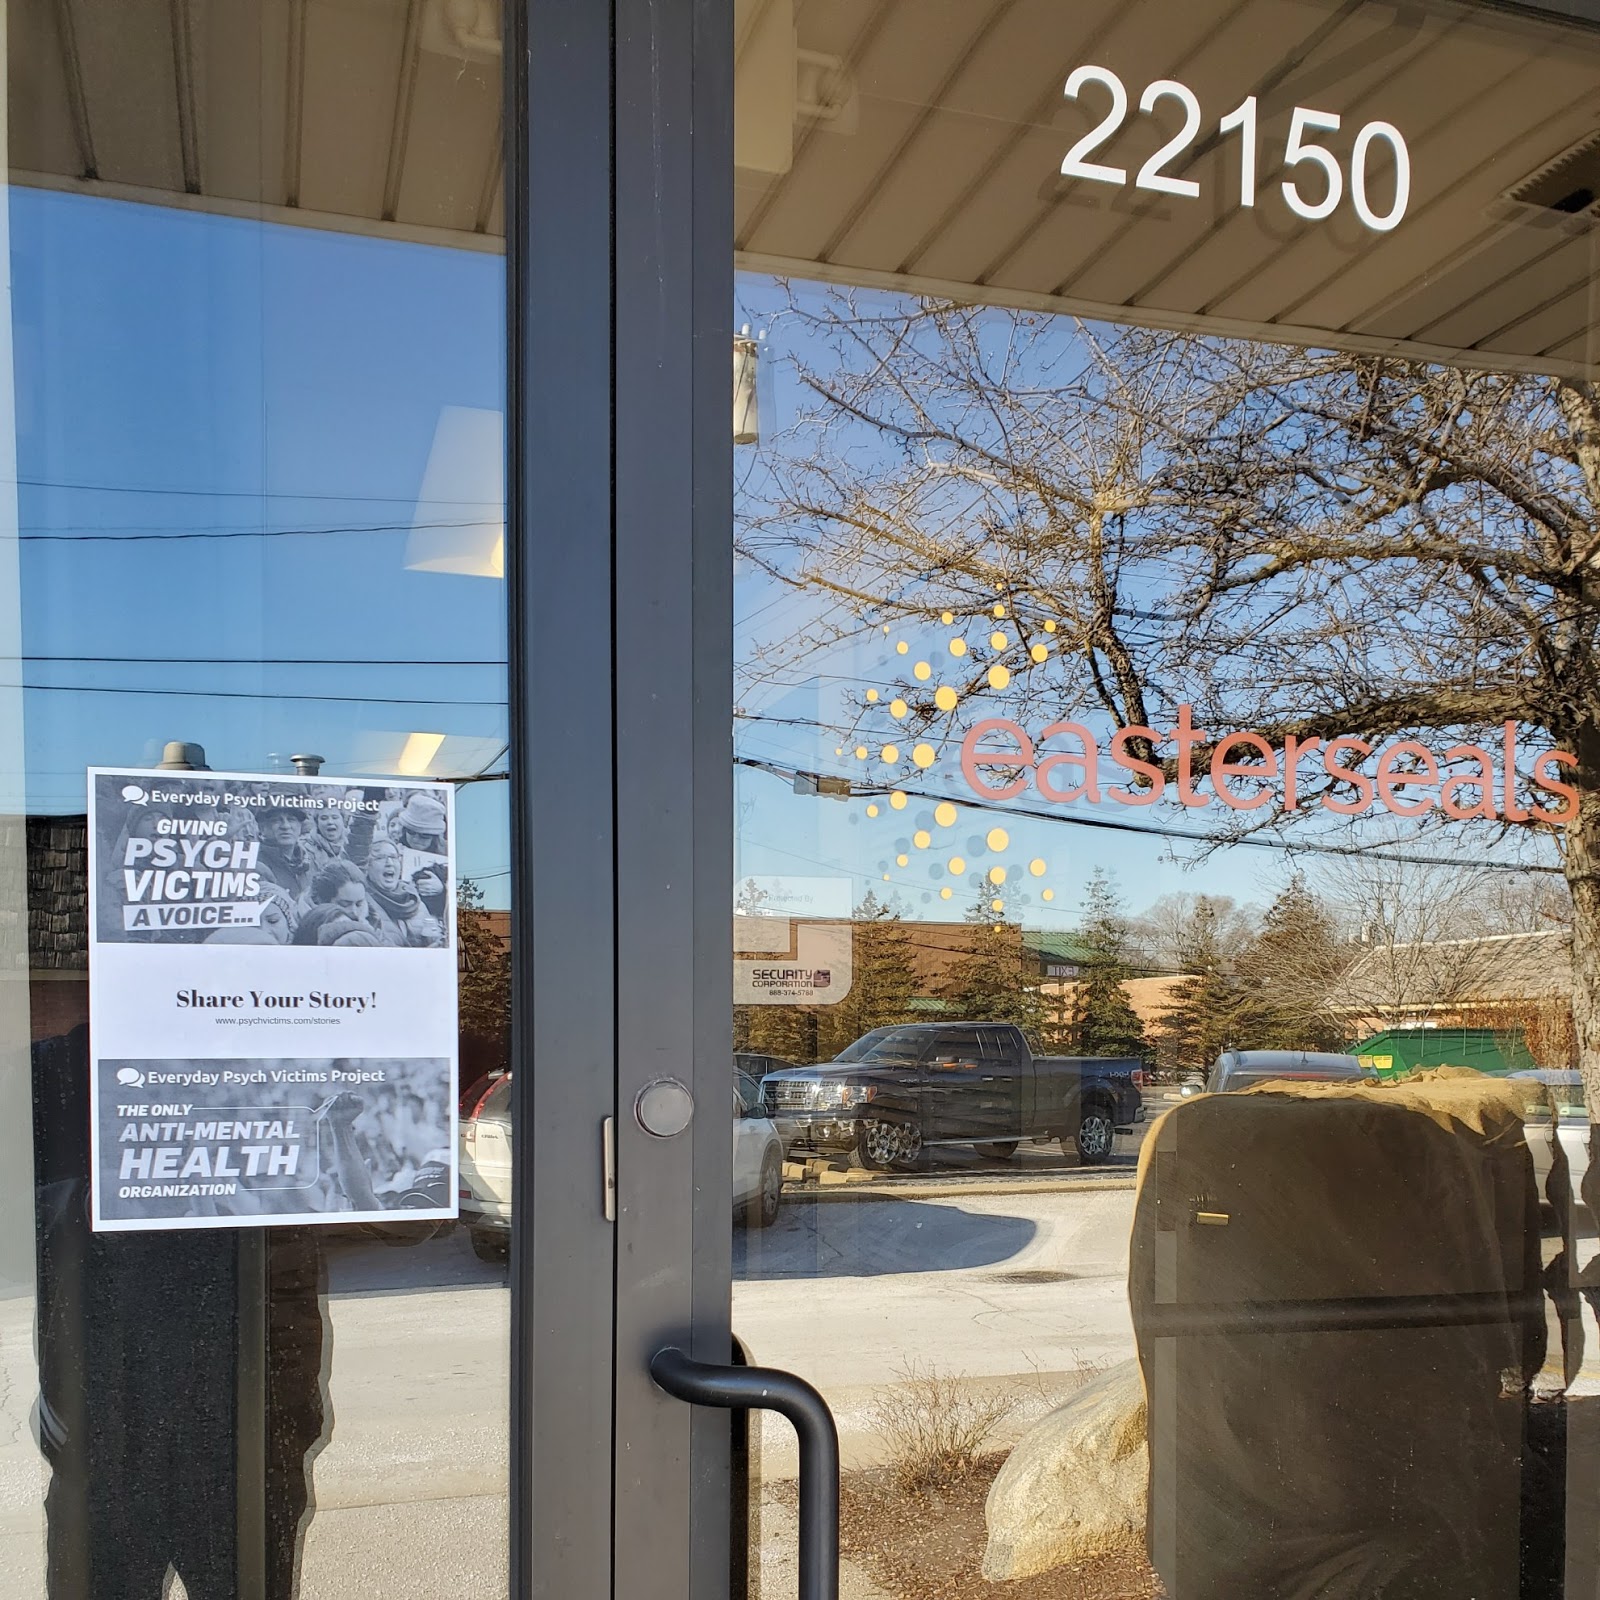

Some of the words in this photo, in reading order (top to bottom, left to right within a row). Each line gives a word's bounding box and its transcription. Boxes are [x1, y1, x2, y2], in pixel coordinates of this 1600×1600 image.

[1060, 65, 1410, 231] 22150
[961, 704, 1581, 824] easterseals
[151, 789, 221, 807] Everyday
[224, 792, 266, 808] Psych
[269, 794, 324, 810] Victims
[327, 797, 379, 812] Project
[157, 818, 228, 836] GIVING
[124, 837, 260, 869] PSYCH
[124, 869, 261, 902] VICTIMS
[132, 908, 151, 927] A
[158, 905, 254, 926] VOICE...
[752, 969, 813, 980] SECURITY
[752, 980, 813, 988] CORPORATION
[176, 989, 244, 1009] Share
[249, 990, 304, 1009] Your
[308, 990, 377, 1014] Story!
[215, 1016, 341, 1026] www.psychvictims.com/stories
[148, 1070, 219, 1087] Everyday
[223, 1070, 267, 1087] Psych
[270, 1069, 327, 1083] Victims
[331, 1069, 385, 1085] Project
[117, 1104, 148, 1117] THE
[151, 1104, 193, 1116] ONLY
[118, 1120, 300, 1142] ANTI-MENTAL
[118, 1145, 300, 1180] HEALTH
[118, 1183, 237, 1199] ORGANIZATION
